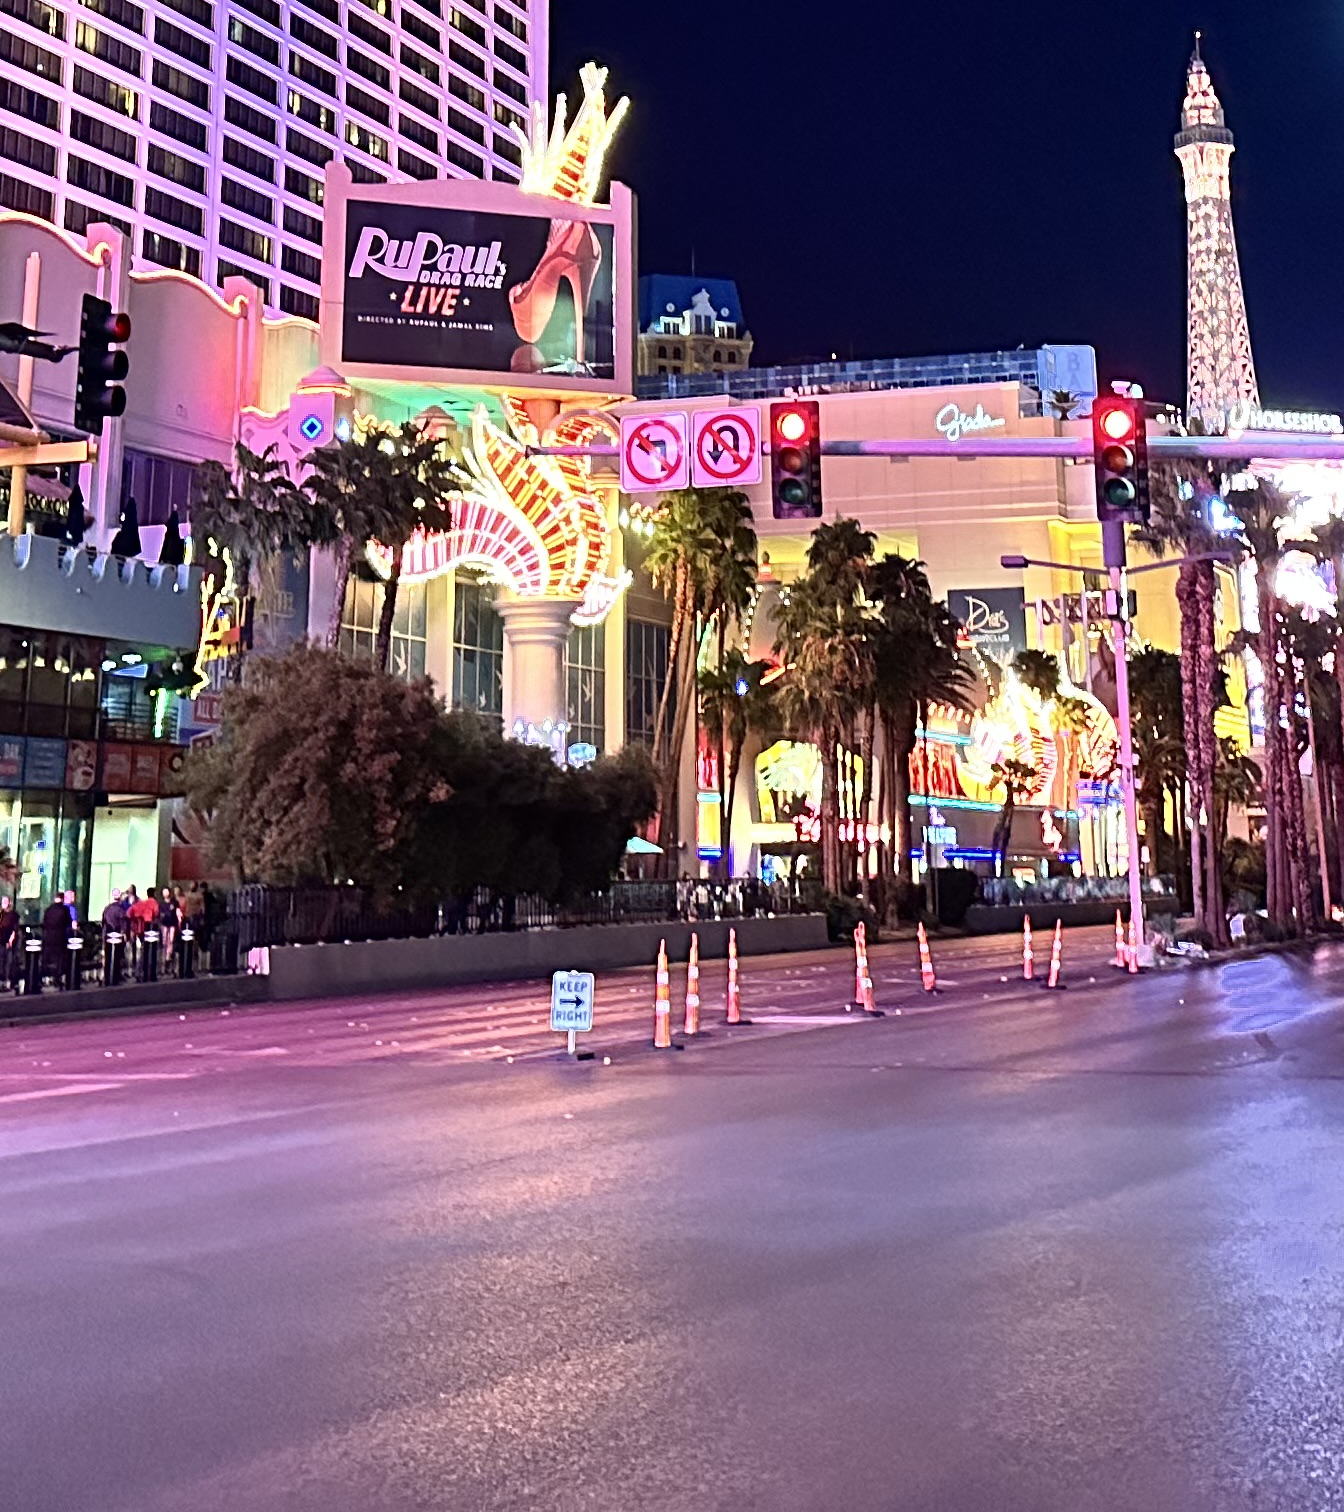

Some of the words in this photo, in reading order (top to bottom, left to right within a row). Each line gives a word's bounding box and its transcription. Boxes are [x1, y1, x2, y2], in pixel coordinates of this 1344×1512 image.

[349, 226, 507, 282] RuPaul's
[419, 270, 461, 286] DRAG
[464, 274, 504, 289] RACE
[400, 284, 460, 316] LIVE
[559, 981, 587, 992] KEEP
[556, 1010, 587, 1022] RIGHT
